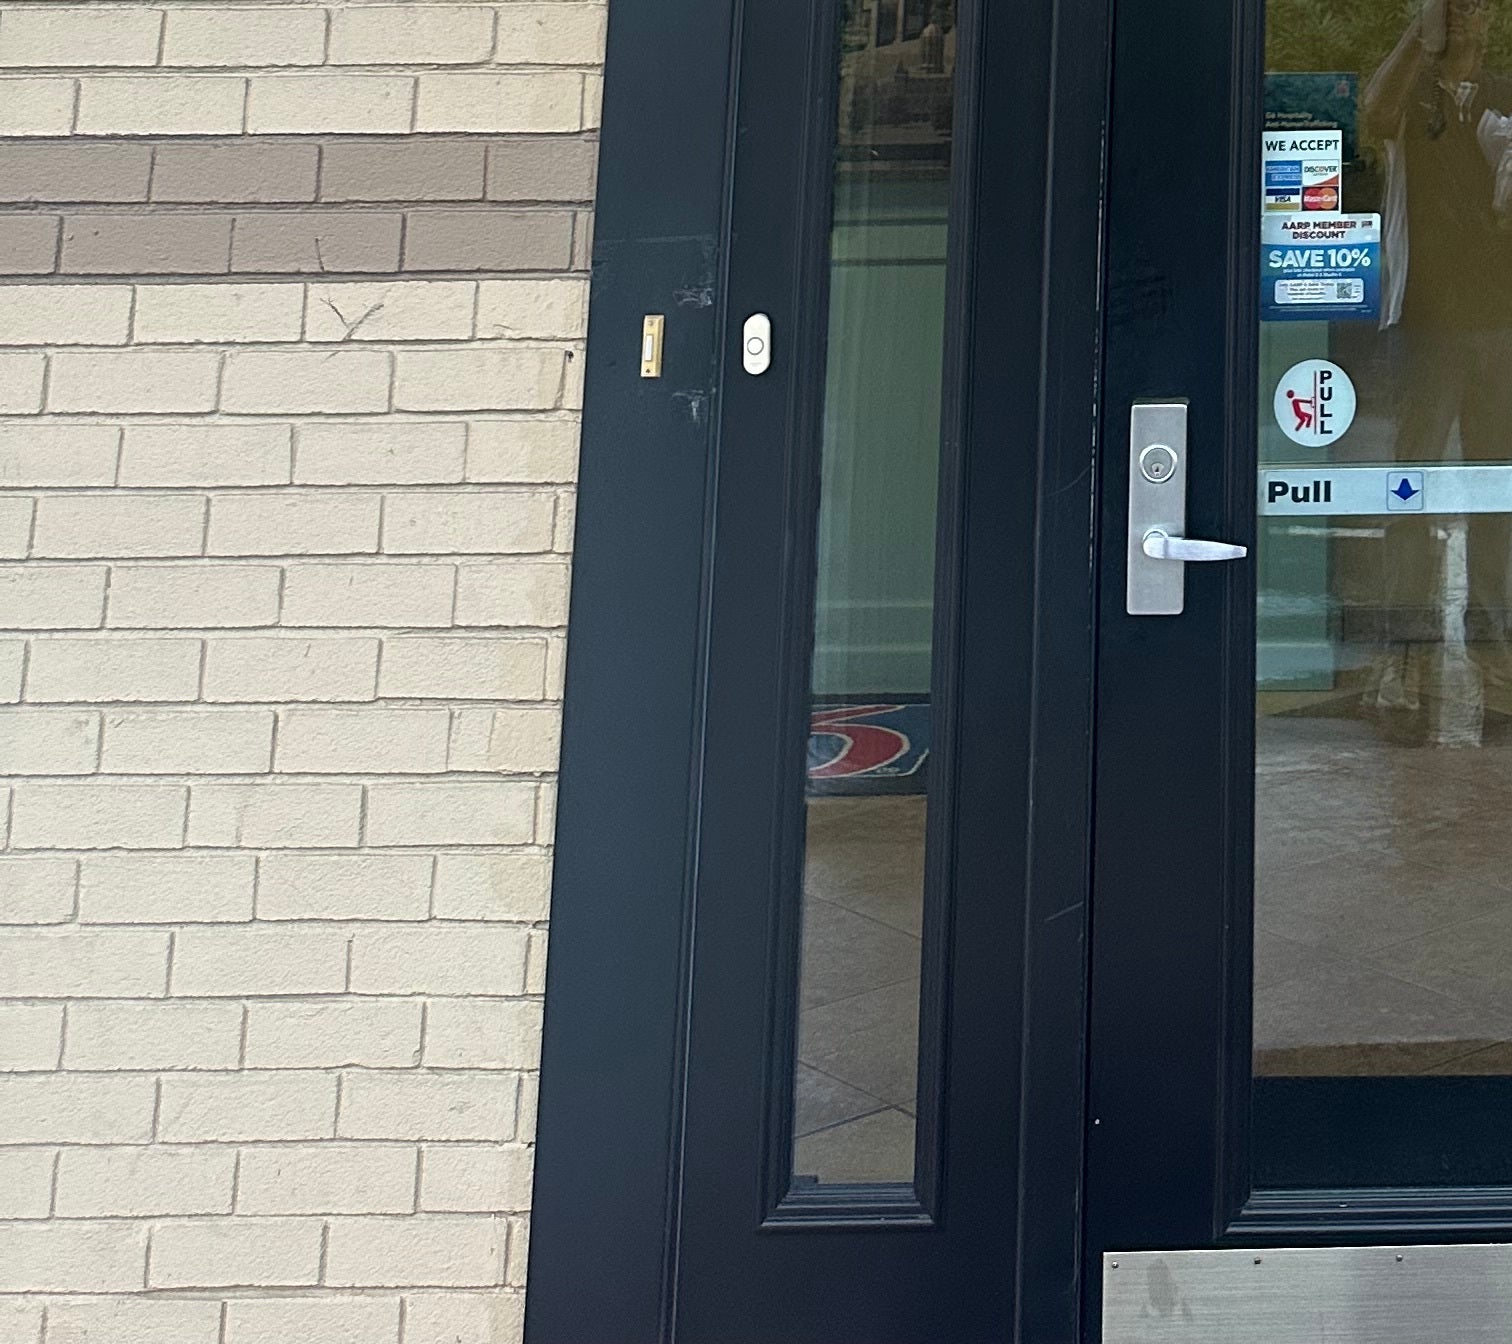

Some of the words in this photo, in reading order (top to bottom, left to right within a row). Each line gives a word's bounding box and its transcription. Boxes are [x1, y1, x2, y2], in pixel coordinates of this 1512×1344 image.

[1265, 141, 1286, 152] WE
[1290, 140, 1340, 151] ACCEPT
[1274, 195, 1292, 203] VISA
[1281, 221, 1311, 230] AARP
[1313, 220, 1357, 229] MEMBER
[1292, 230, 1346, 240] DISCOUNT
[1269, 249, 1325, 268] SAVE
[1328, 248, 1371, 267] 10%
[1320, 370, 1333, 435] PULL
[1267, 480, 1332, 503] Pull
